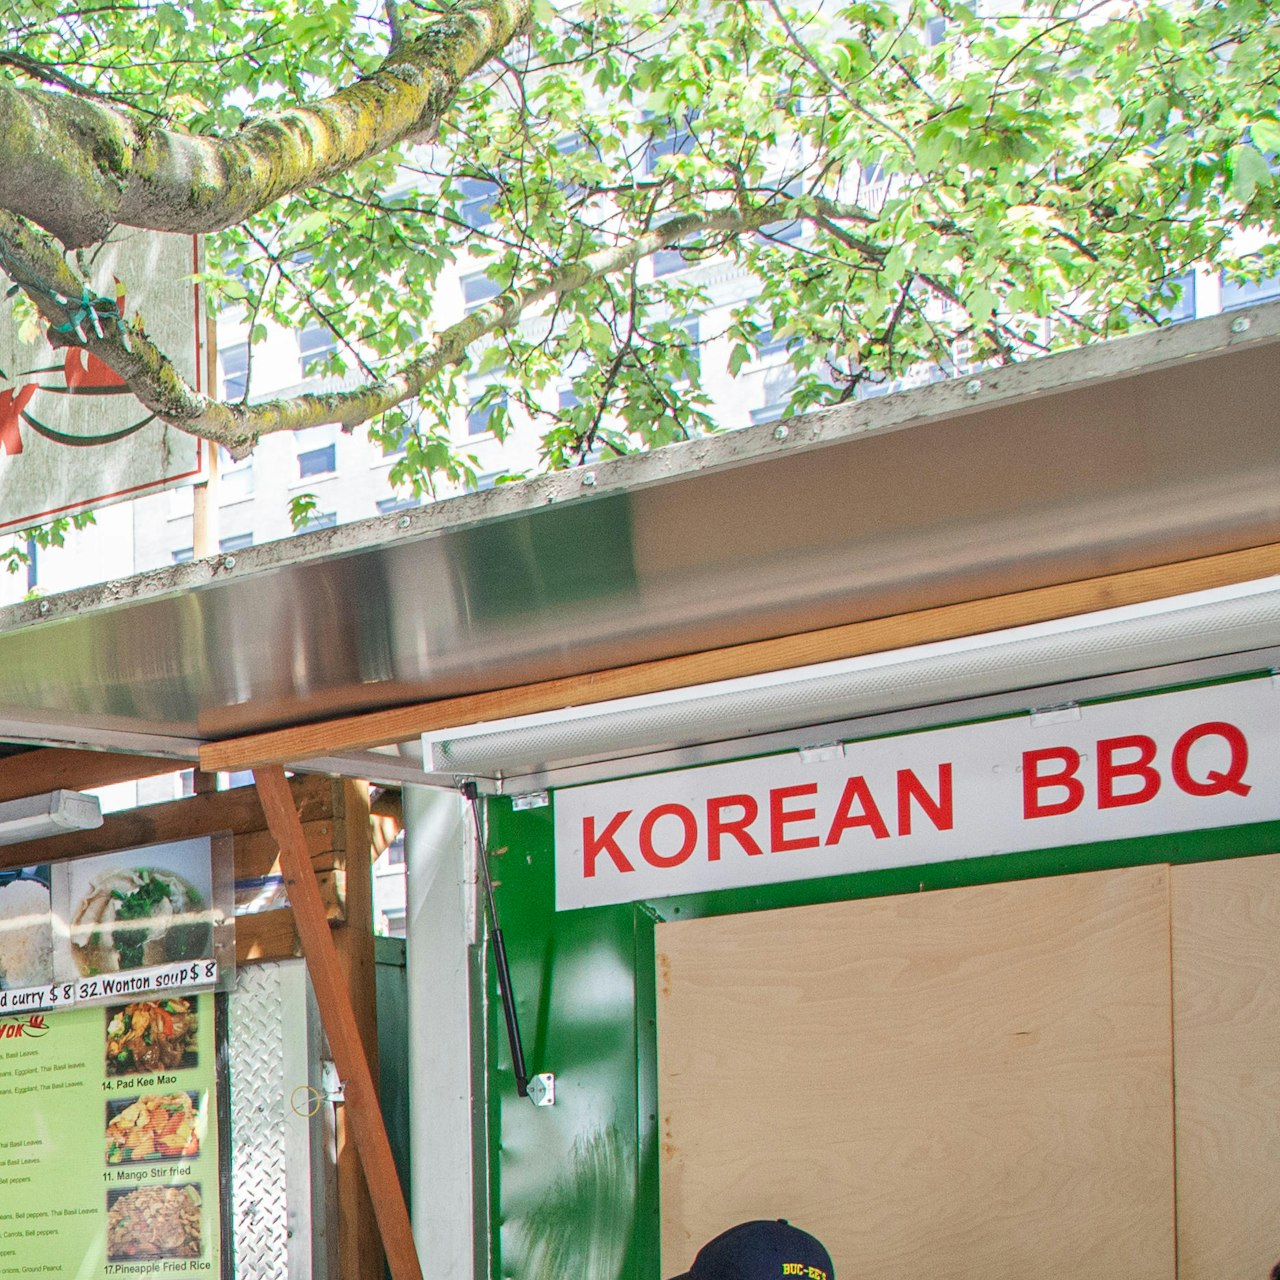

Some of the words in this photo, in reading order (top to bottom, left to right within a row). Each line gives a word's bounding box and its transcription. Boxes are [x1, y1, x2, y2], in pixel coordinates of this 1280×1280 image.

[582, 762, 952, 878] KOREAN
[1022, 721, 1251, 819] BBQ
[156, 970, 187, 986] soup
[190, 963, 199, 982] $
[206, 963, 215, 977] 8
[12, 991, 43, 1005] curry
[50, 985, 57, 1002] $
[64, 985, 71, 998] 8
[102, 1082, 113, 1090] 14.
[117, 1079, 134, 1089] Pad
[137, 1077, 154, 1087] Kee
[157, 1075, 176, 1084] Mao
[103, 1173, 114, 1181] 11.
[117, 1170, 148, 1182] Mango
[151, 1168, 167, 1178] Stir
[170, 1167, 190, 1176] fried
[163, 1263, 187, 1271] Fried
[190, 1261, 210, 1270] Rice
